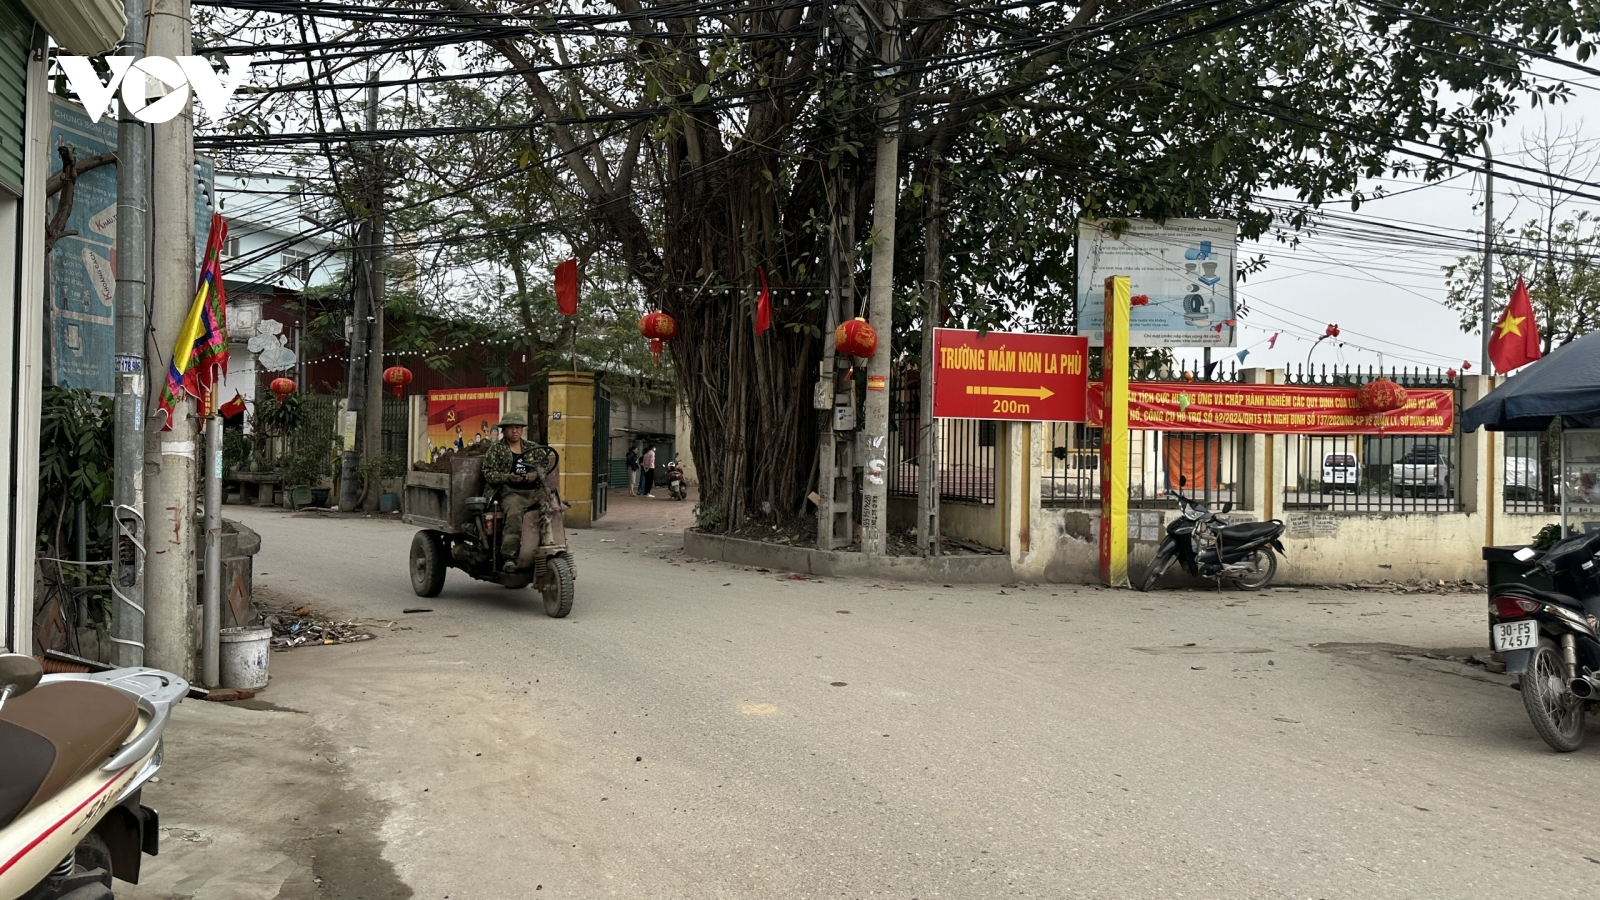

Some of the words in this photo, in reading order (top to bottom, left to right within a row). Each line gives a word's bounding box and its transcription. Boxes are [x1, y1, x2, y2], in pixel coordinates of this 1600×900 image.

[54, 109, 83, 126] CHUNG
[940, 343, 985, 371] TRƯỜNG
[988, 344, 1016, 372] MẦM
[1018, 351, 1042, 374] NON
[1045, 353, 1058, 374] LA
[1060, 350, 1082, 375] PHÙ
[992, 399, 1030, 414] 200m
[1138, 389, 1154, 403] TÍCH
[1156, 391, 1171, 406] CỰC
[1198, 391, 1213, 405] ỨNG
[1214, 391, 1224, 406] VÀ
[1225, 390, 1243, 406] CHẤP
[1245, 392, 1264, 407] HÀNH
[1266, 393, 1291, 408] NGHIÊM
[1292, 393, 1305, 408] CÁC
[1306, 395, 1319, 409] QUY
[1320, 397, 1334, 410] ĐỊNH
[1335, 394, 1347, 409] CỦA
[1143, 408, 1163, 421] CÔNG
[1165, 411, 1175, 424] CỤ
[1188, 411, 1202, 425] TRỢ
[1203, 409, 1213, 423] SỐ
[1214, 411, 1262, 425] 42/2024/QH15
[1263, 411, 1272, 425] VÀ
[1273, 413, 1289, 427] NGHỊ
[1290, 414, 1306, 428] ĐỊNH
[1306, 411, 1316, 425] SỐ
[1317, 414, 1364, 427] 137/2020/NĐ-CP
[1400, 412, 1409, 426] SỬ
[1410, 415, 1426, 428] DỤNG
[1426, 413, 1444, 426] PHÁO
[1500, 622, 1531, 637] 30-F5
[1500, 635, 1531, 648] 7457
